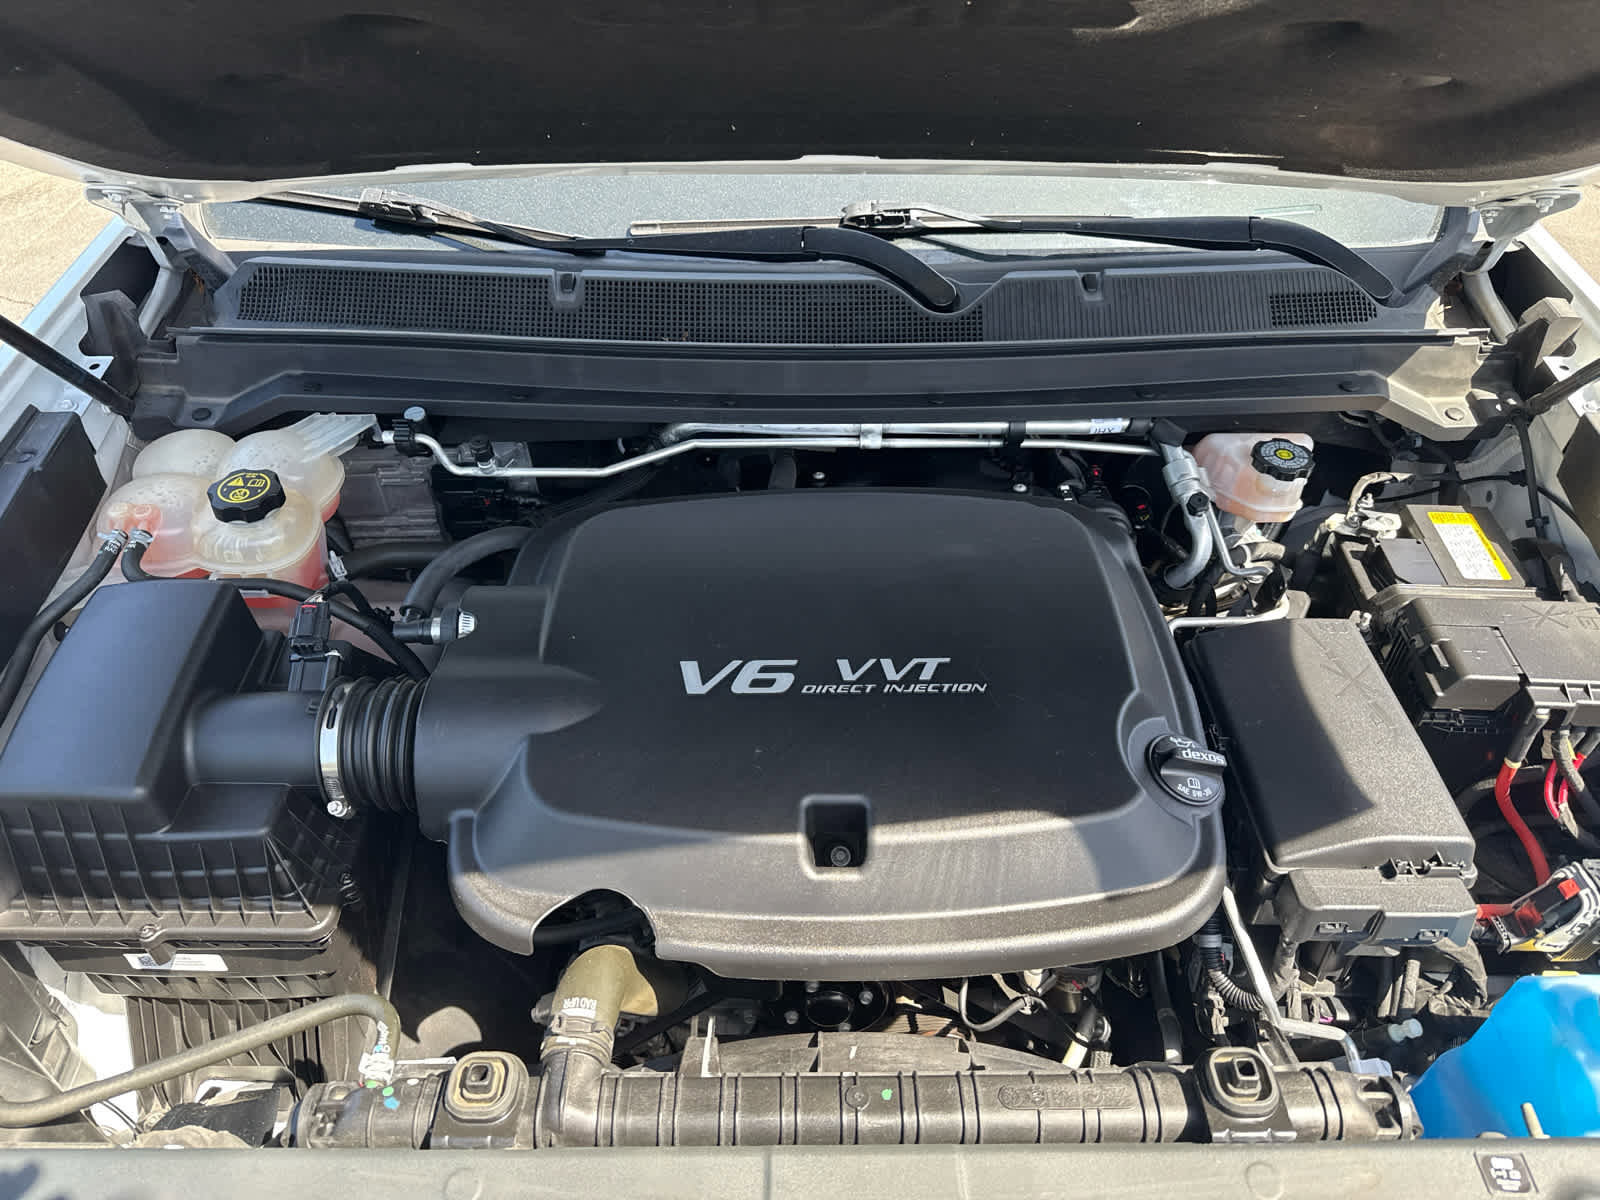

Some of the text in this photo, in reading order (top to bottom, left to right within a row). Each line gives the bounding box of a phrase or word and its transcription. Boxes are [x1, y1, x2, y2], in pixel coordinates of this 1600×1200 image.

[680, 659, 798, 694] V6
[837, 657, 951, 681] VVT
[801, 682, 988, 694] DIRECT INJECTION
[1182, 748, 1225, 764] dexos
[1177, 784, 1191, 795] SAE
